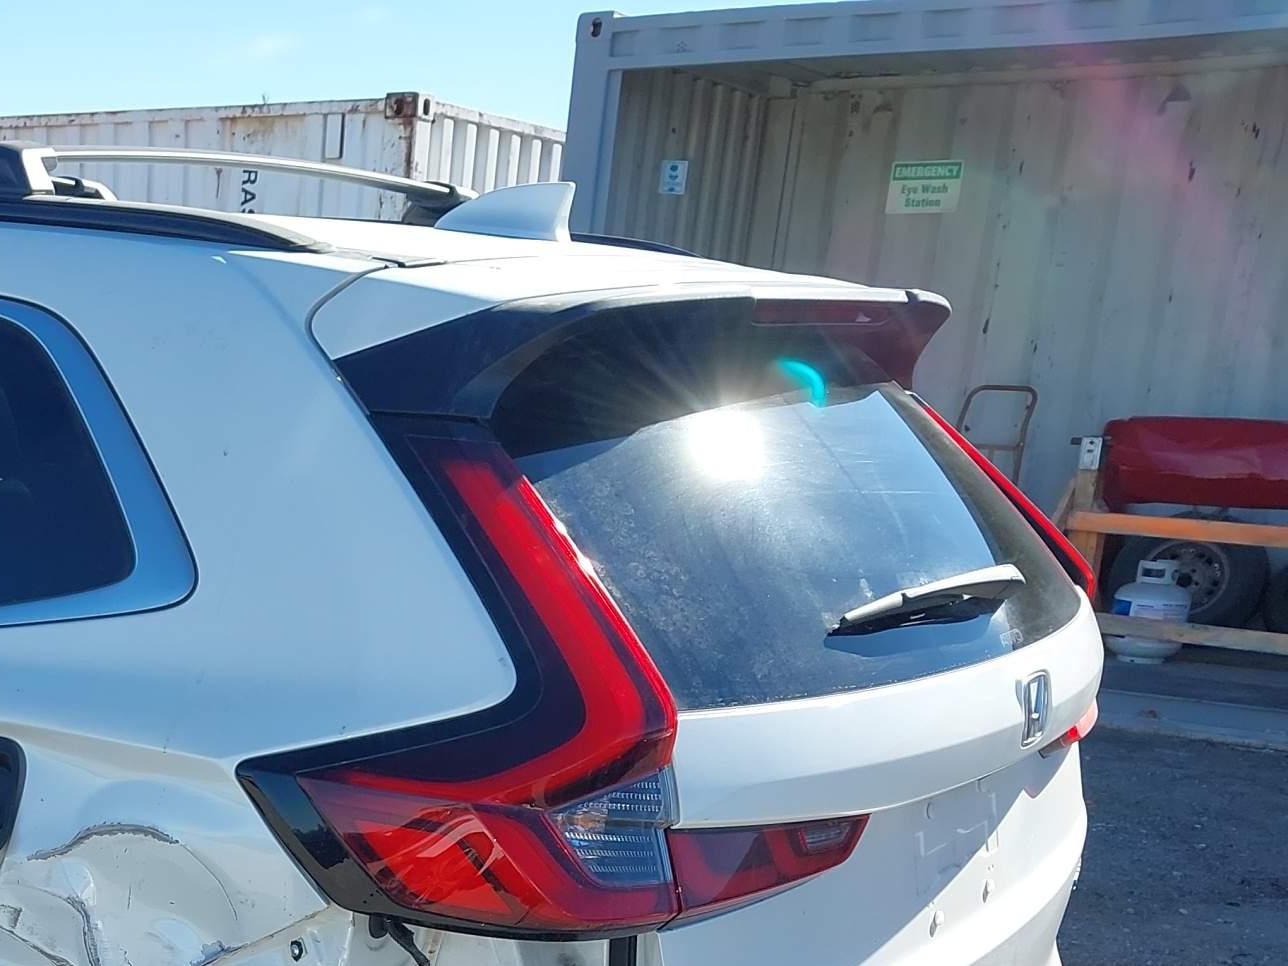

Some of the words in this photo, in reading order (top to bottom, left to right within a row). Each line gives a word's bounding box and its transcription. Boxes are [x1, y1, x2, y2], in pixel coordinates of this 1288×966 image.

[894, 166, 960, 178] EMERGENCY
[241, 169, 258, 213] RA
[901, 184, 918, 196] Eye
[921, 183, 949, 194] Wash
[904, 198, 942, 208] Station
